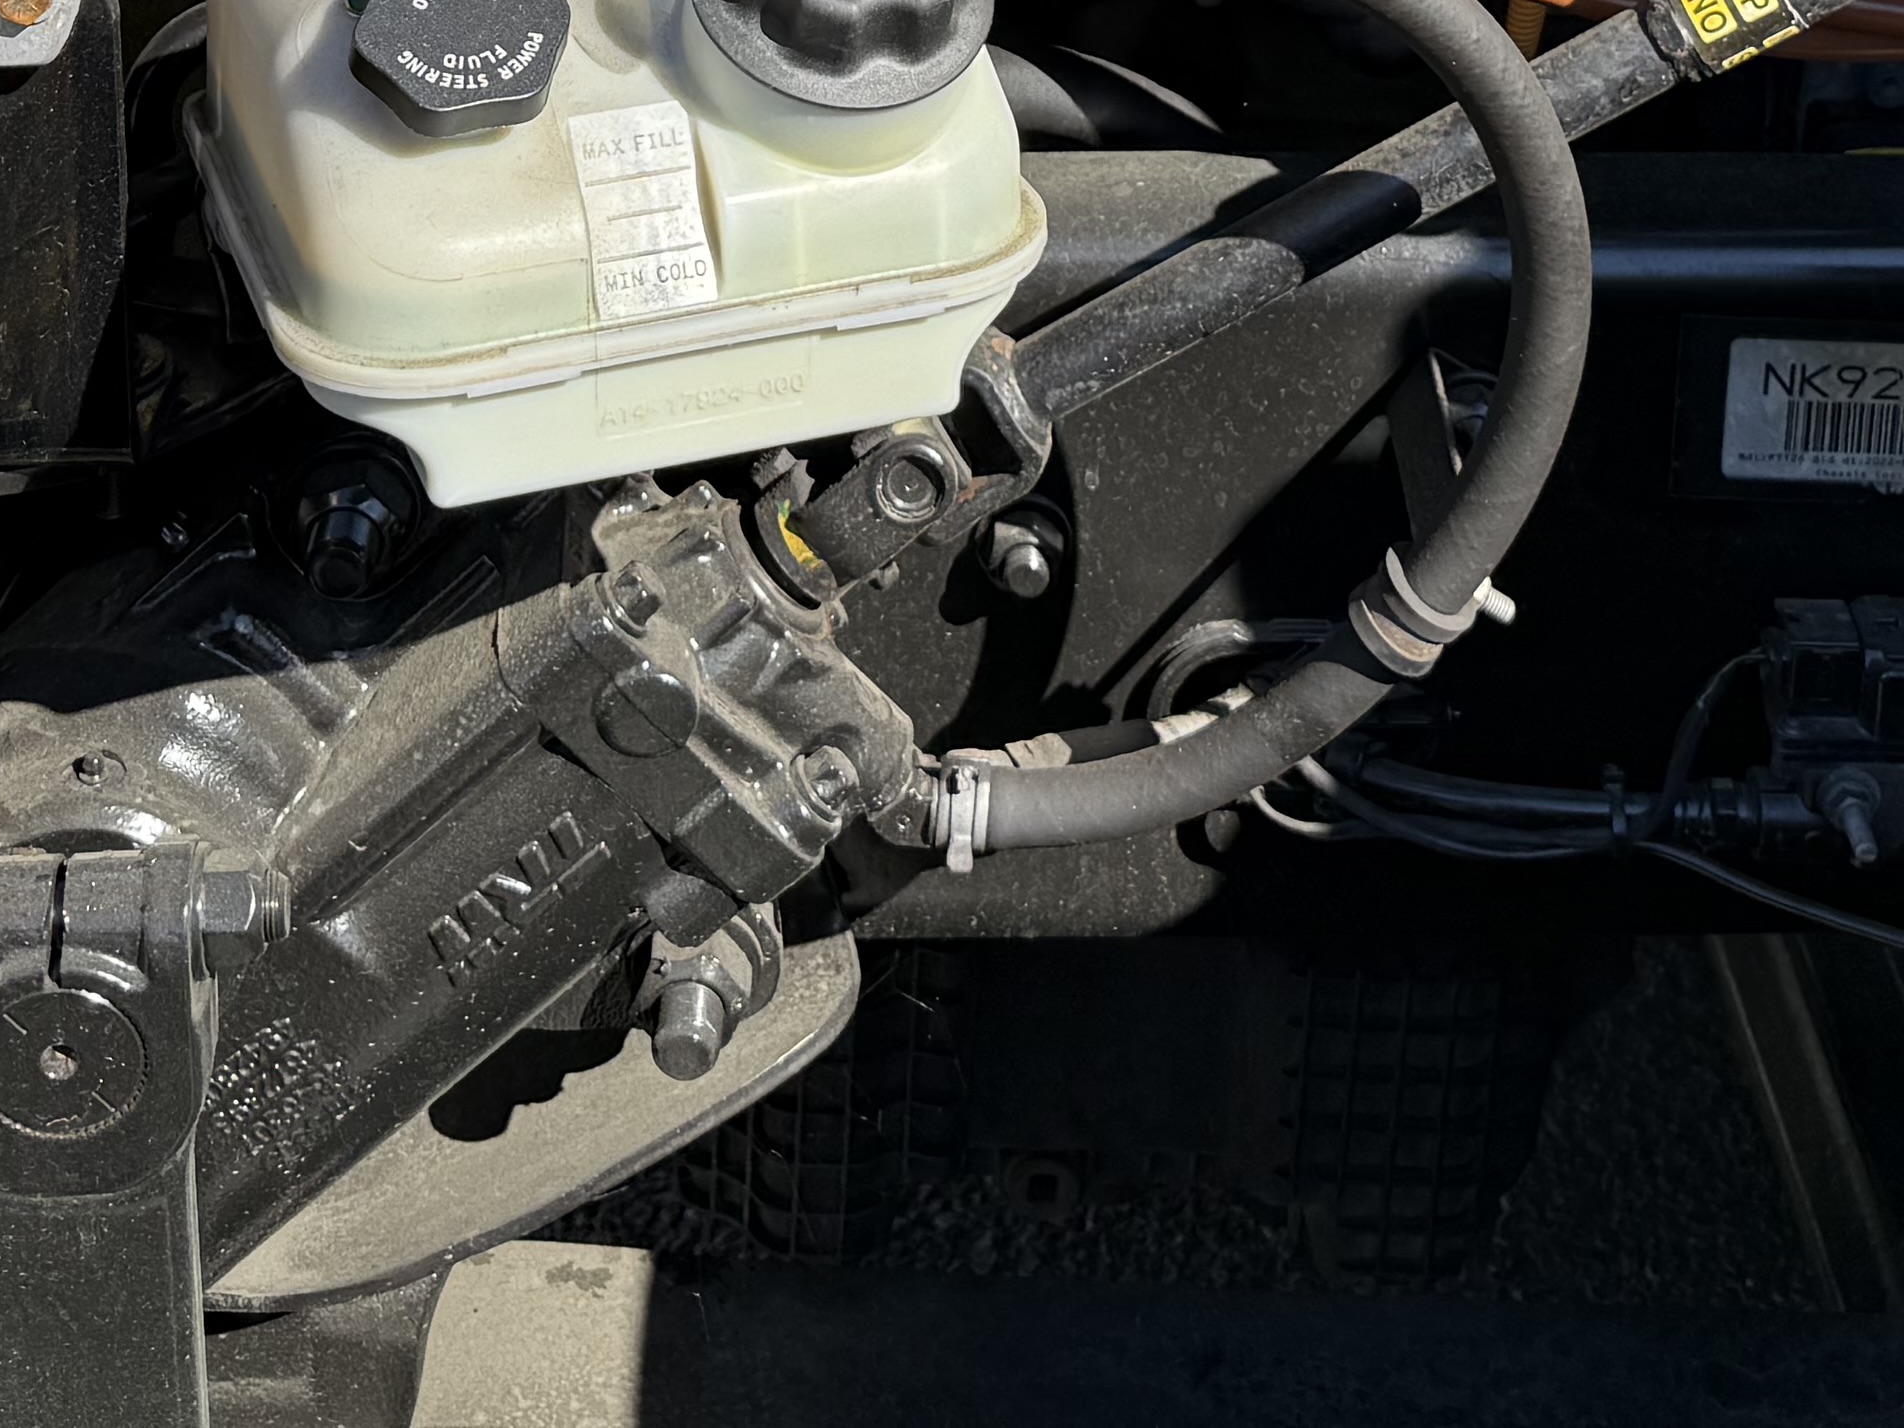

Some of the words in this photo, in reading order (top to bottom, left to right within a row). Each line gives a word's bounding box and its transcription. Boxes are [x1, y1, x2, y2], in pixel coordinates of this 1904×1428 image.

[396, 50, 490, 90] STEERING
[443, 44, 508, 69] FLUID
[497, 30, 545, 80] POWER
[582, 138, 625, 161] MAX
[633, 126, 684, 152] FILL
[604, 273, 643, 294] MIN
[656, 259, 707, 285] COLD
